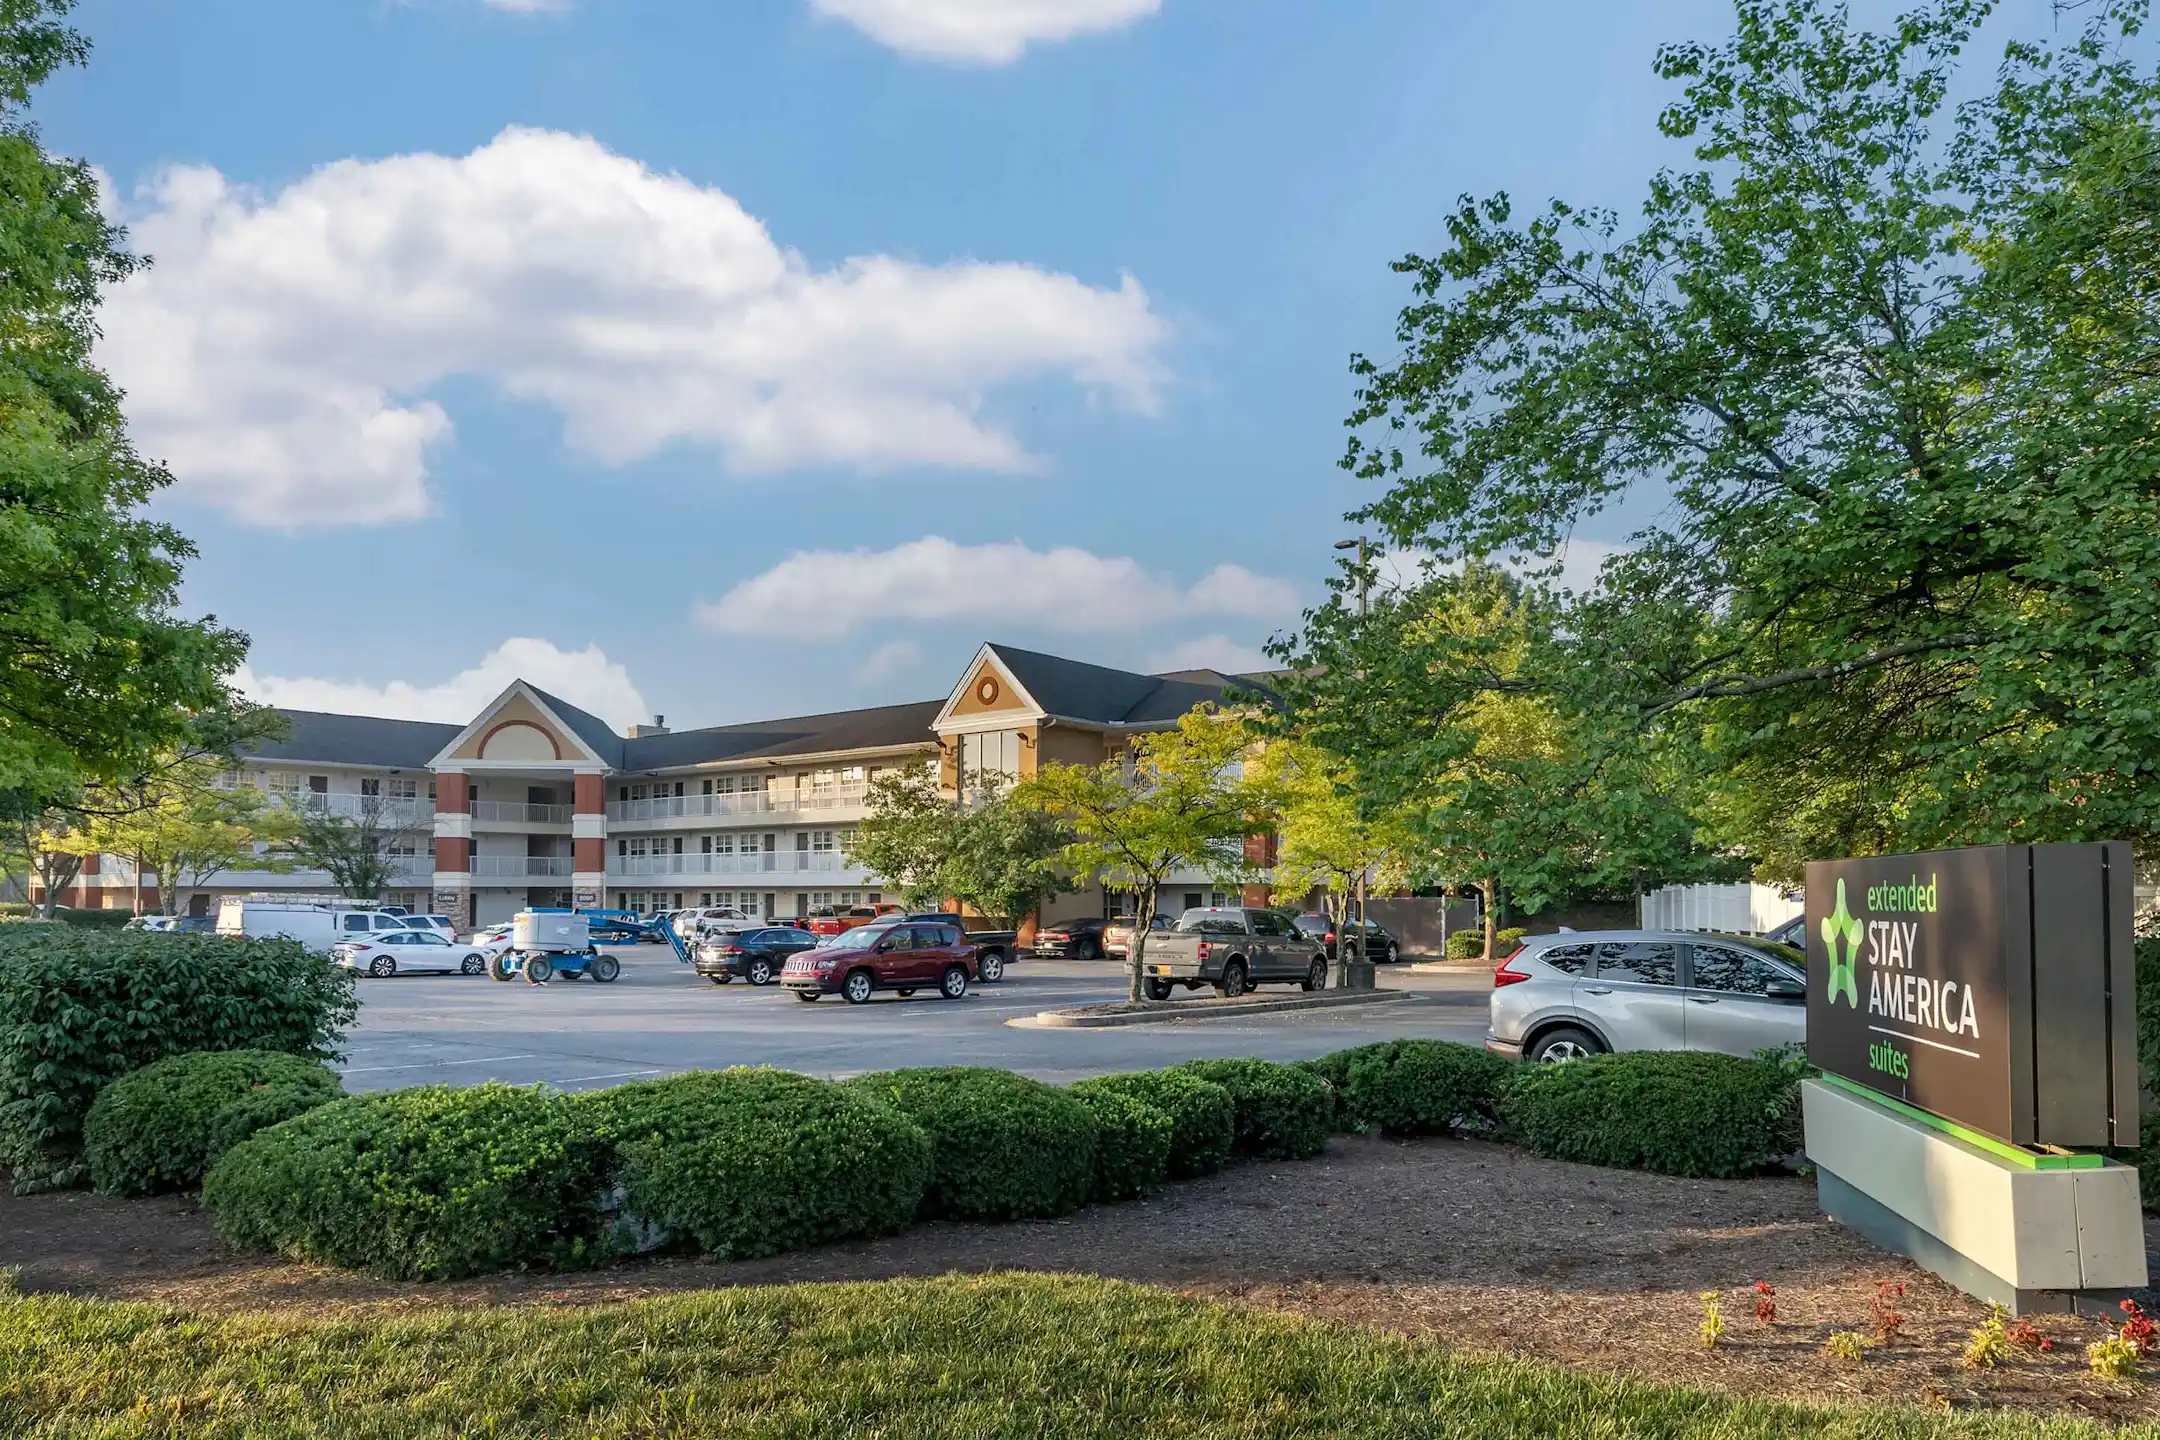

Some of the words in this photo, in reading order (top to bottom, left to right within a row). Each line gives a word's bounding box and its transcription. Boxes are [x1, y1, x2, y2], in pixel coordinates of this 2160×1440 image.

[1867, 872, 1937, 913] extended
[1868, 920, 1918, 969] STAY
[1868, 970, 1980, 1039] AMERICA
[1869, 1039, 1909, 1080] suites
